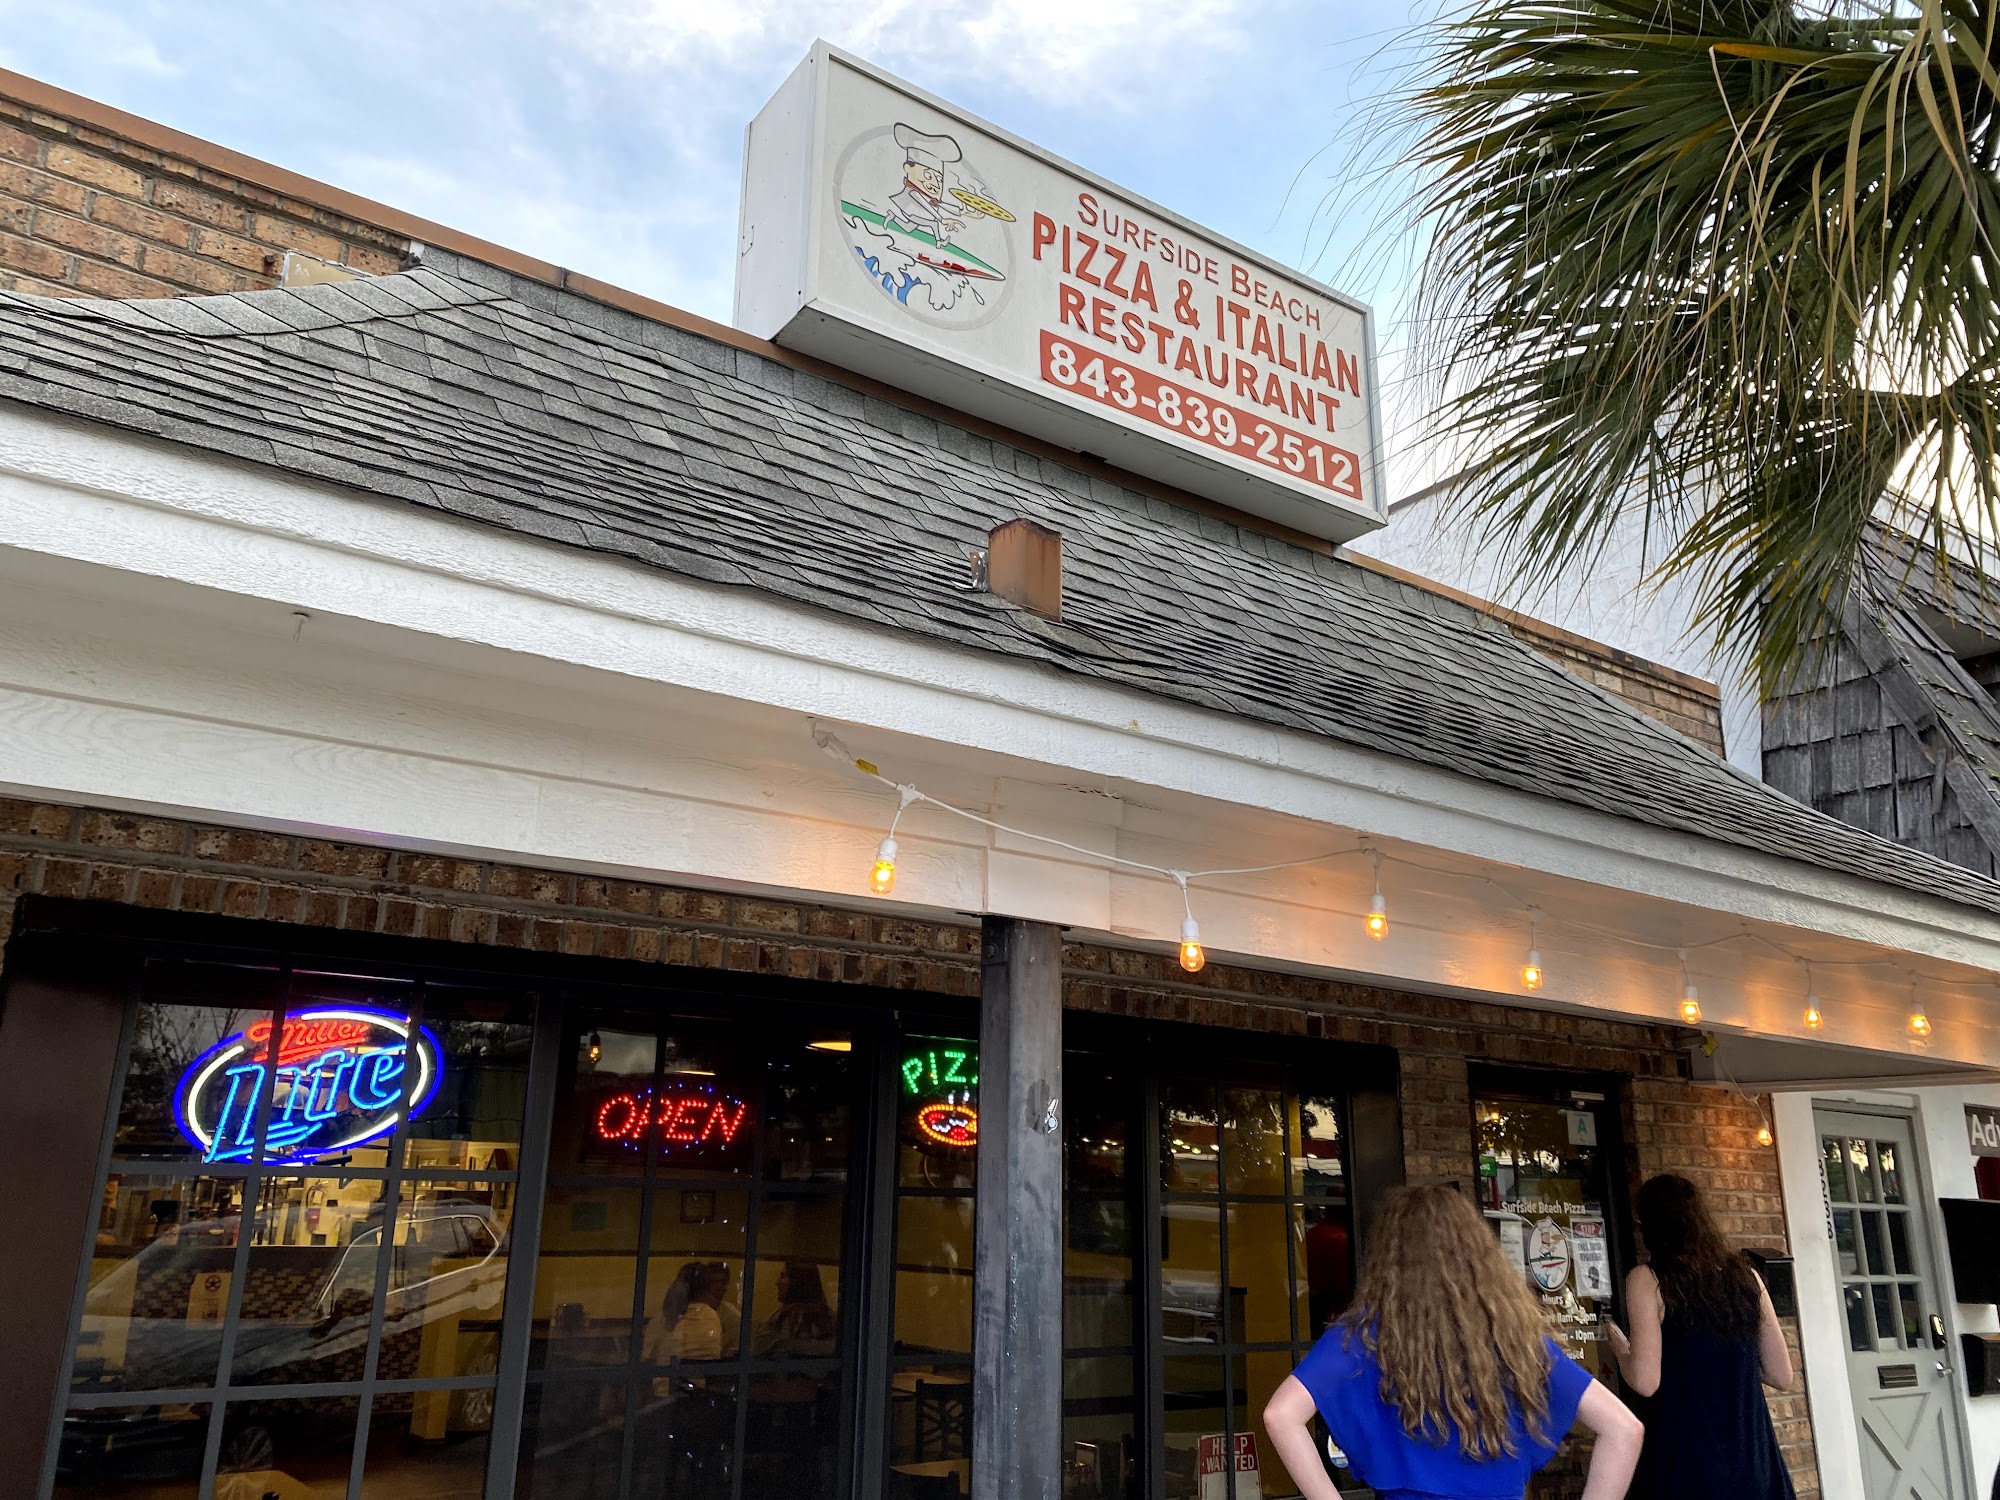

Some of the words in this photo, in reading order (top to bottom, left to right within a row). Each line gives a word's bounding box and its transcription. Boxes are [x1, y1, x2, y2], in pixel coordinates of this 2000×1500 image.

[1033, 211, 1159, 313] PIZZA
[1173, 278, 1200, 330] &
[1216, 295, 1361, 398] ITALIAN
[1060, 282, 1341, 433] RESTAURANT
[1049, 342, 1355, 493] 843-839-2512
[248, 1019, 370, 1052] Miller
[204, 1045, 408, 1163] Lite
[598, 1095, 746, 1142] OPEN
[1501, 1199, 1537, 1214] Surfside
[1539, 1200, 1562, 1215] Beach
[1563, 1201, 1586, 1215] Pizza
[1542, 1293, 1564, 1305] Hours
[1575, 1329, 1595, 1343] 10pm
[1212, 1436, 1248, 1456] HELP
[1206, 1453, 1255, 1473] WANTED
